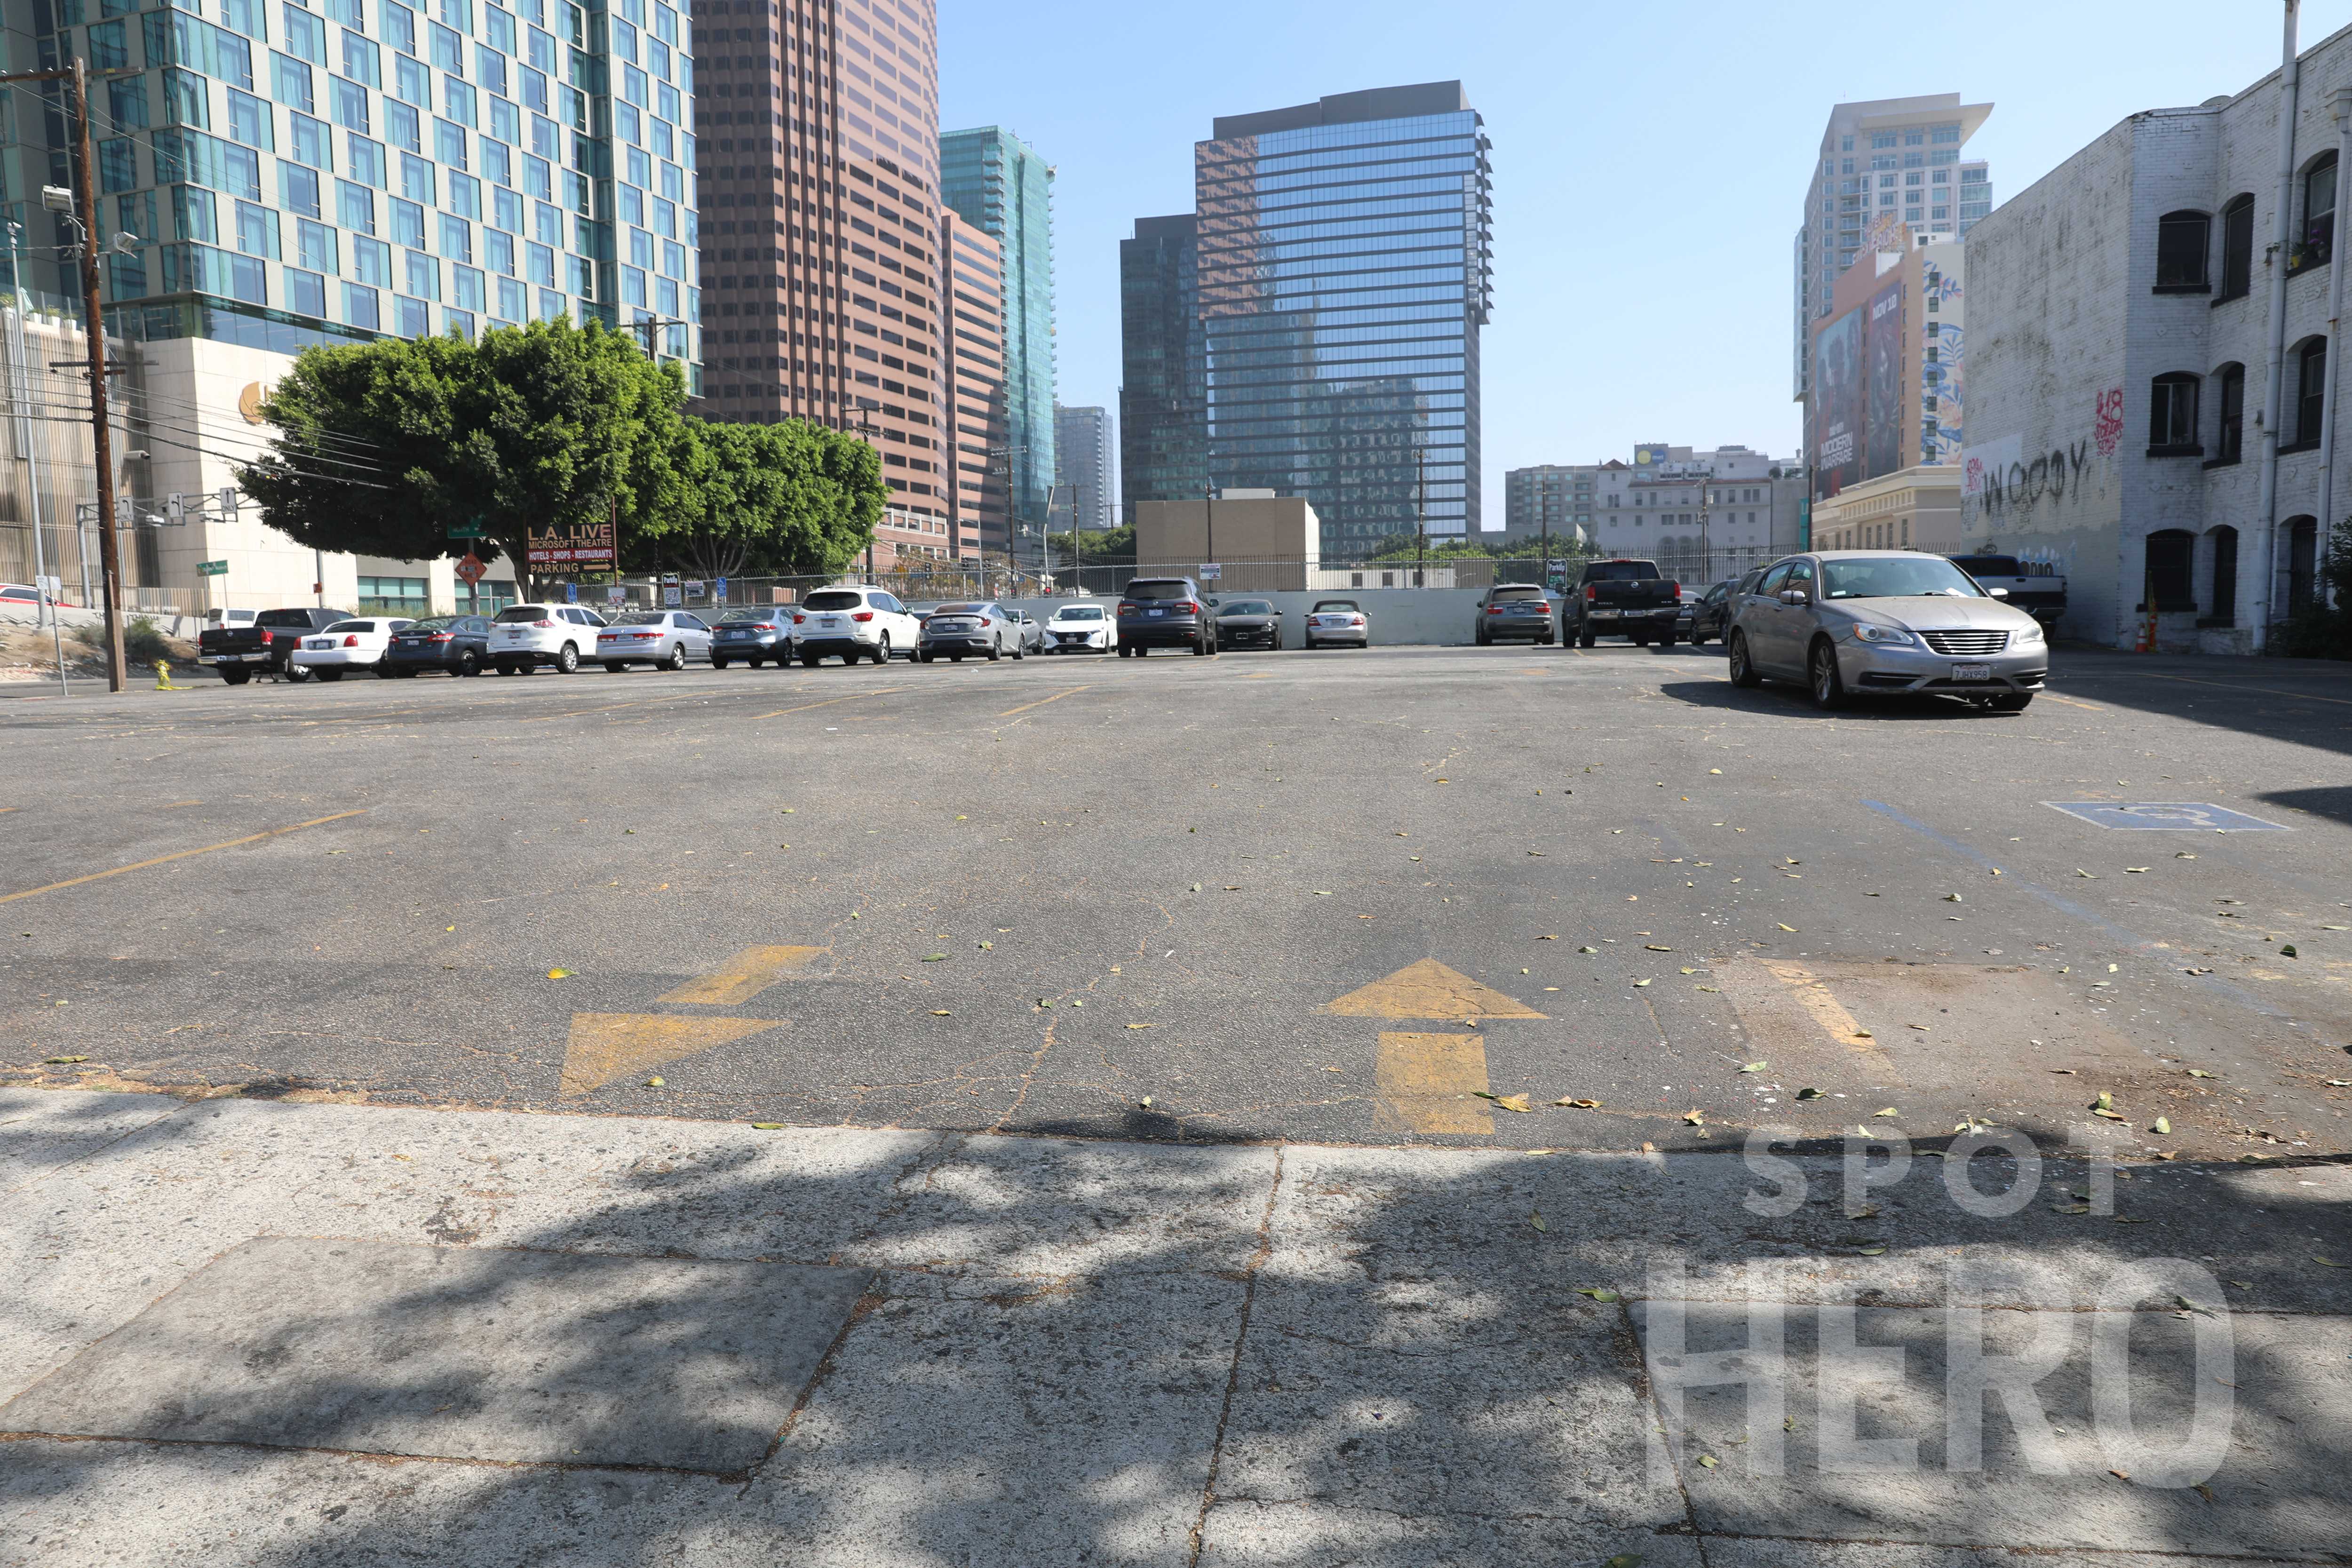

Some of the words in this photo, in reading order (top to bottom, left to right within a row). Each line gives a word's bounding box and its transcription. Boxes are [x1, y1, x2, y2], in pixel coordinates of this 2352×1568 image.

[1873, 300, 1887, 320] NOV
[1821, 431, 1853, 458] MODERN
[1820, 447, 1853, 471] WARFARE
[528, 526, 563, 541] L.A.
[570, 524, 611, 540] LIVE
[528, 540, 575, 549] MICROSOFT
[578, 539, 612, 548] THEATRE
[529, 551, 549, 561] HOTELS
[553, 550, 571, 560] SHOPS
[575, 549, 612, 559] RESTAURANTS
[531, 563, 579, 573] PARKING
